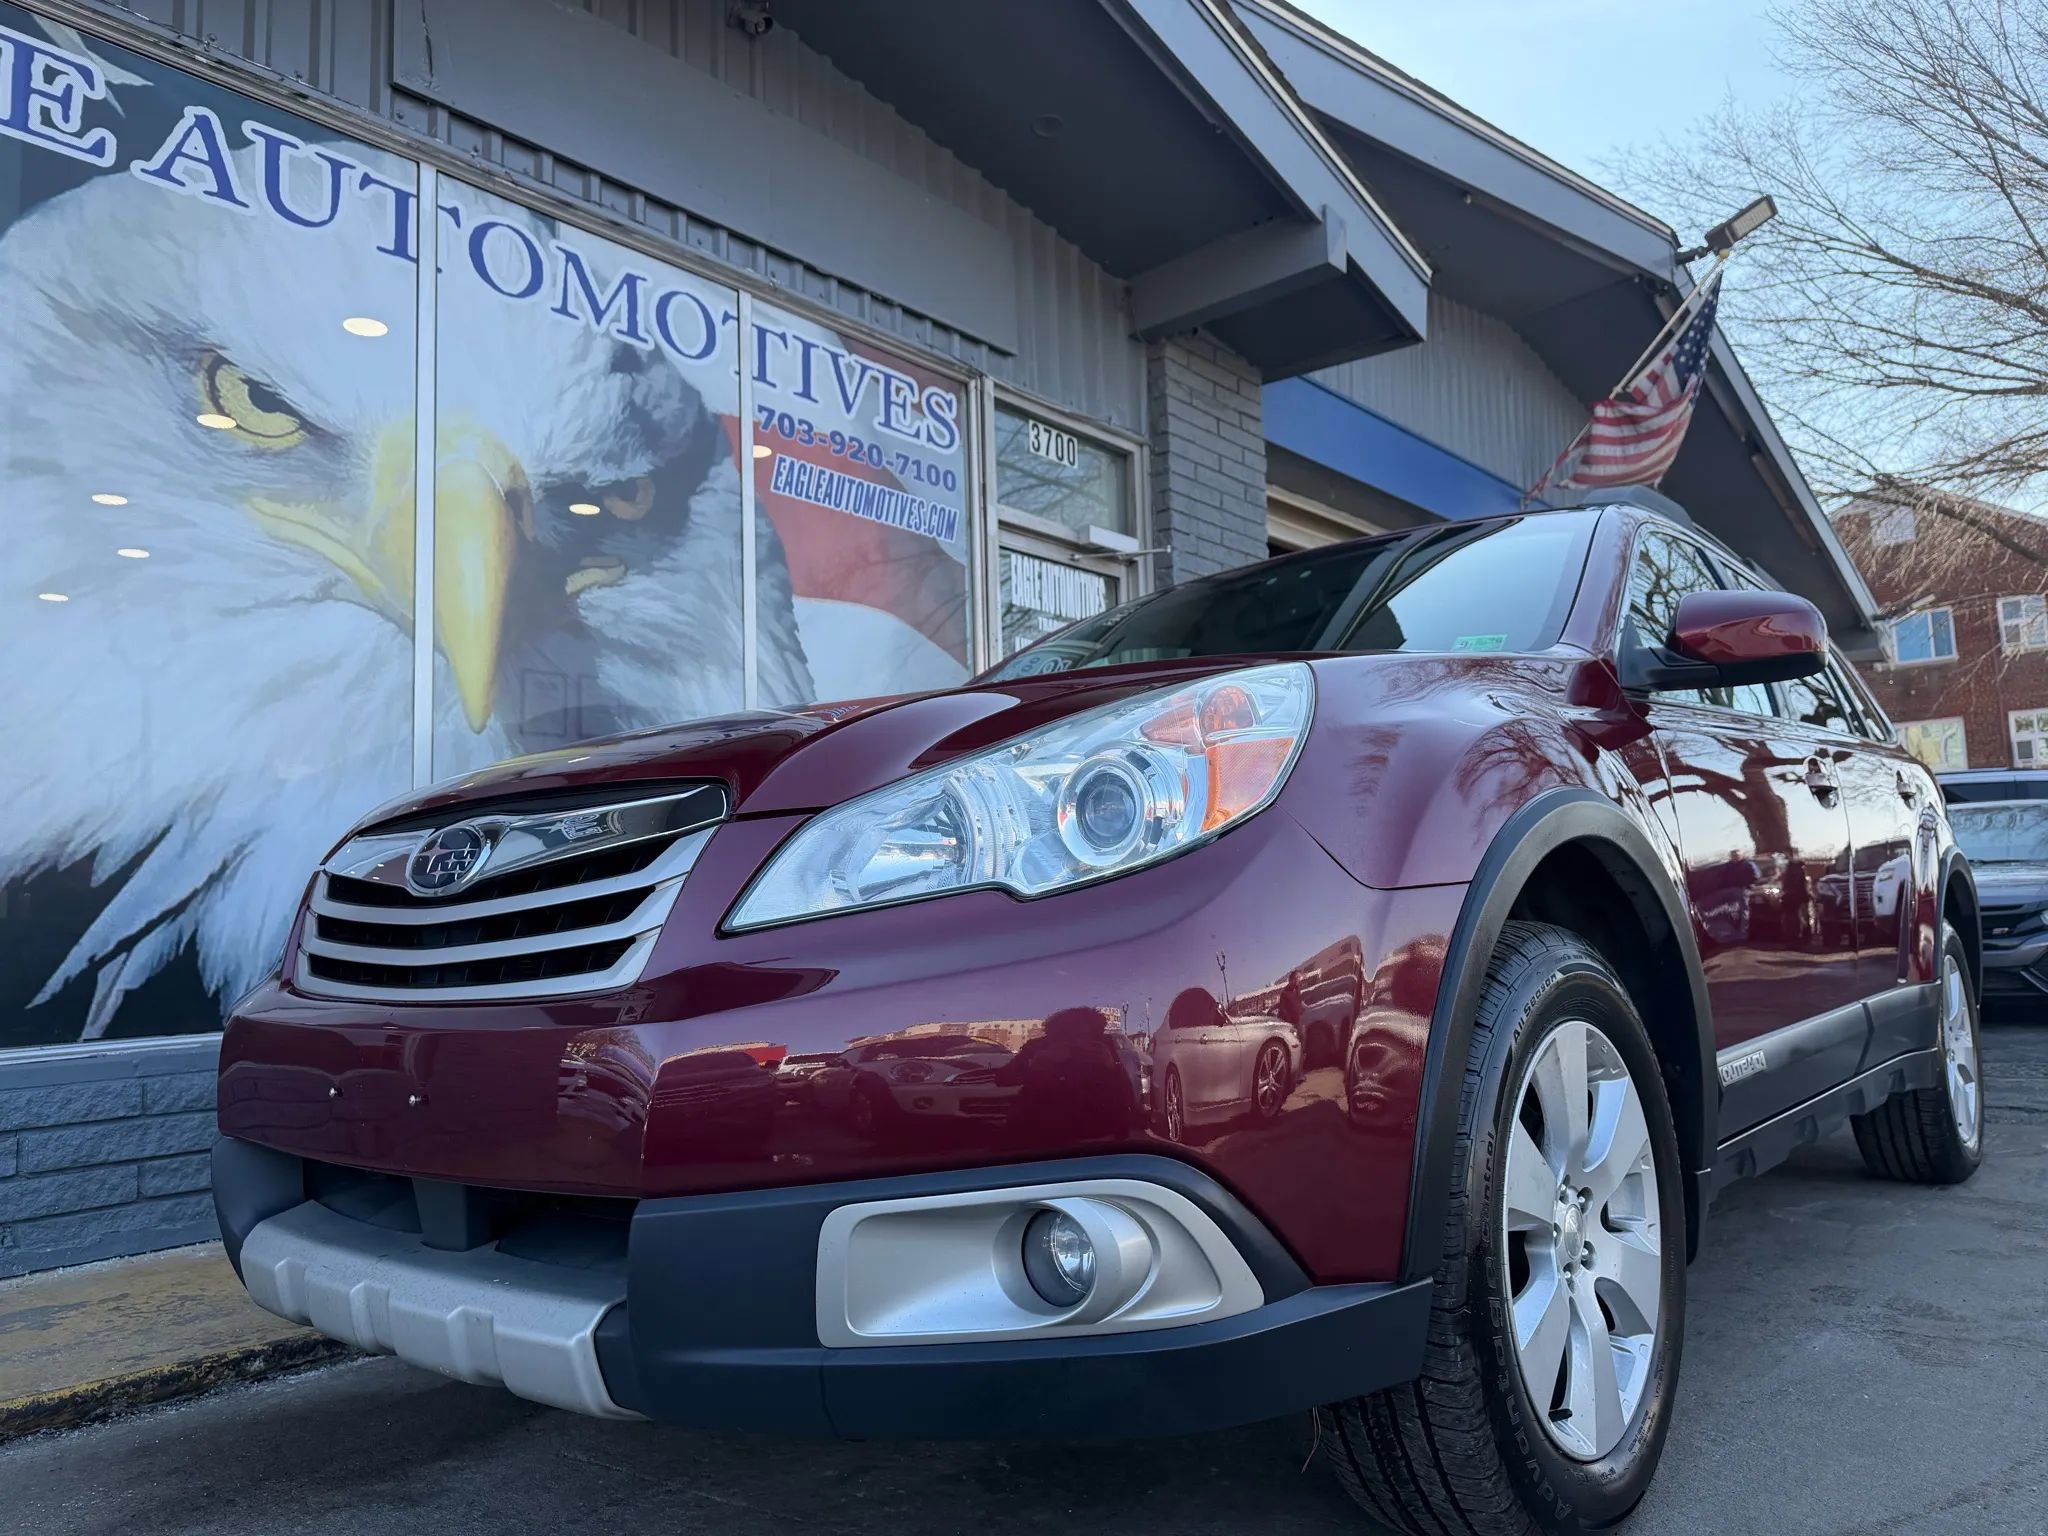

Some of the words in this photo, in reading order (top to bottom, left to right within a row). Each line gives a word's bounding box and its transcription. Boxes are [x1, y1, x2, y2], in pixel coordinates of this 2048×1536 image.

[138, 112, 957, 450] AUTOMOTIVES
[757, 404, 958, 492] 703-920-7100
[1031, 422, 1076, 467] 3700
[772, 456, 958, 541] EAGLEAUTOMOTIVES.COM
